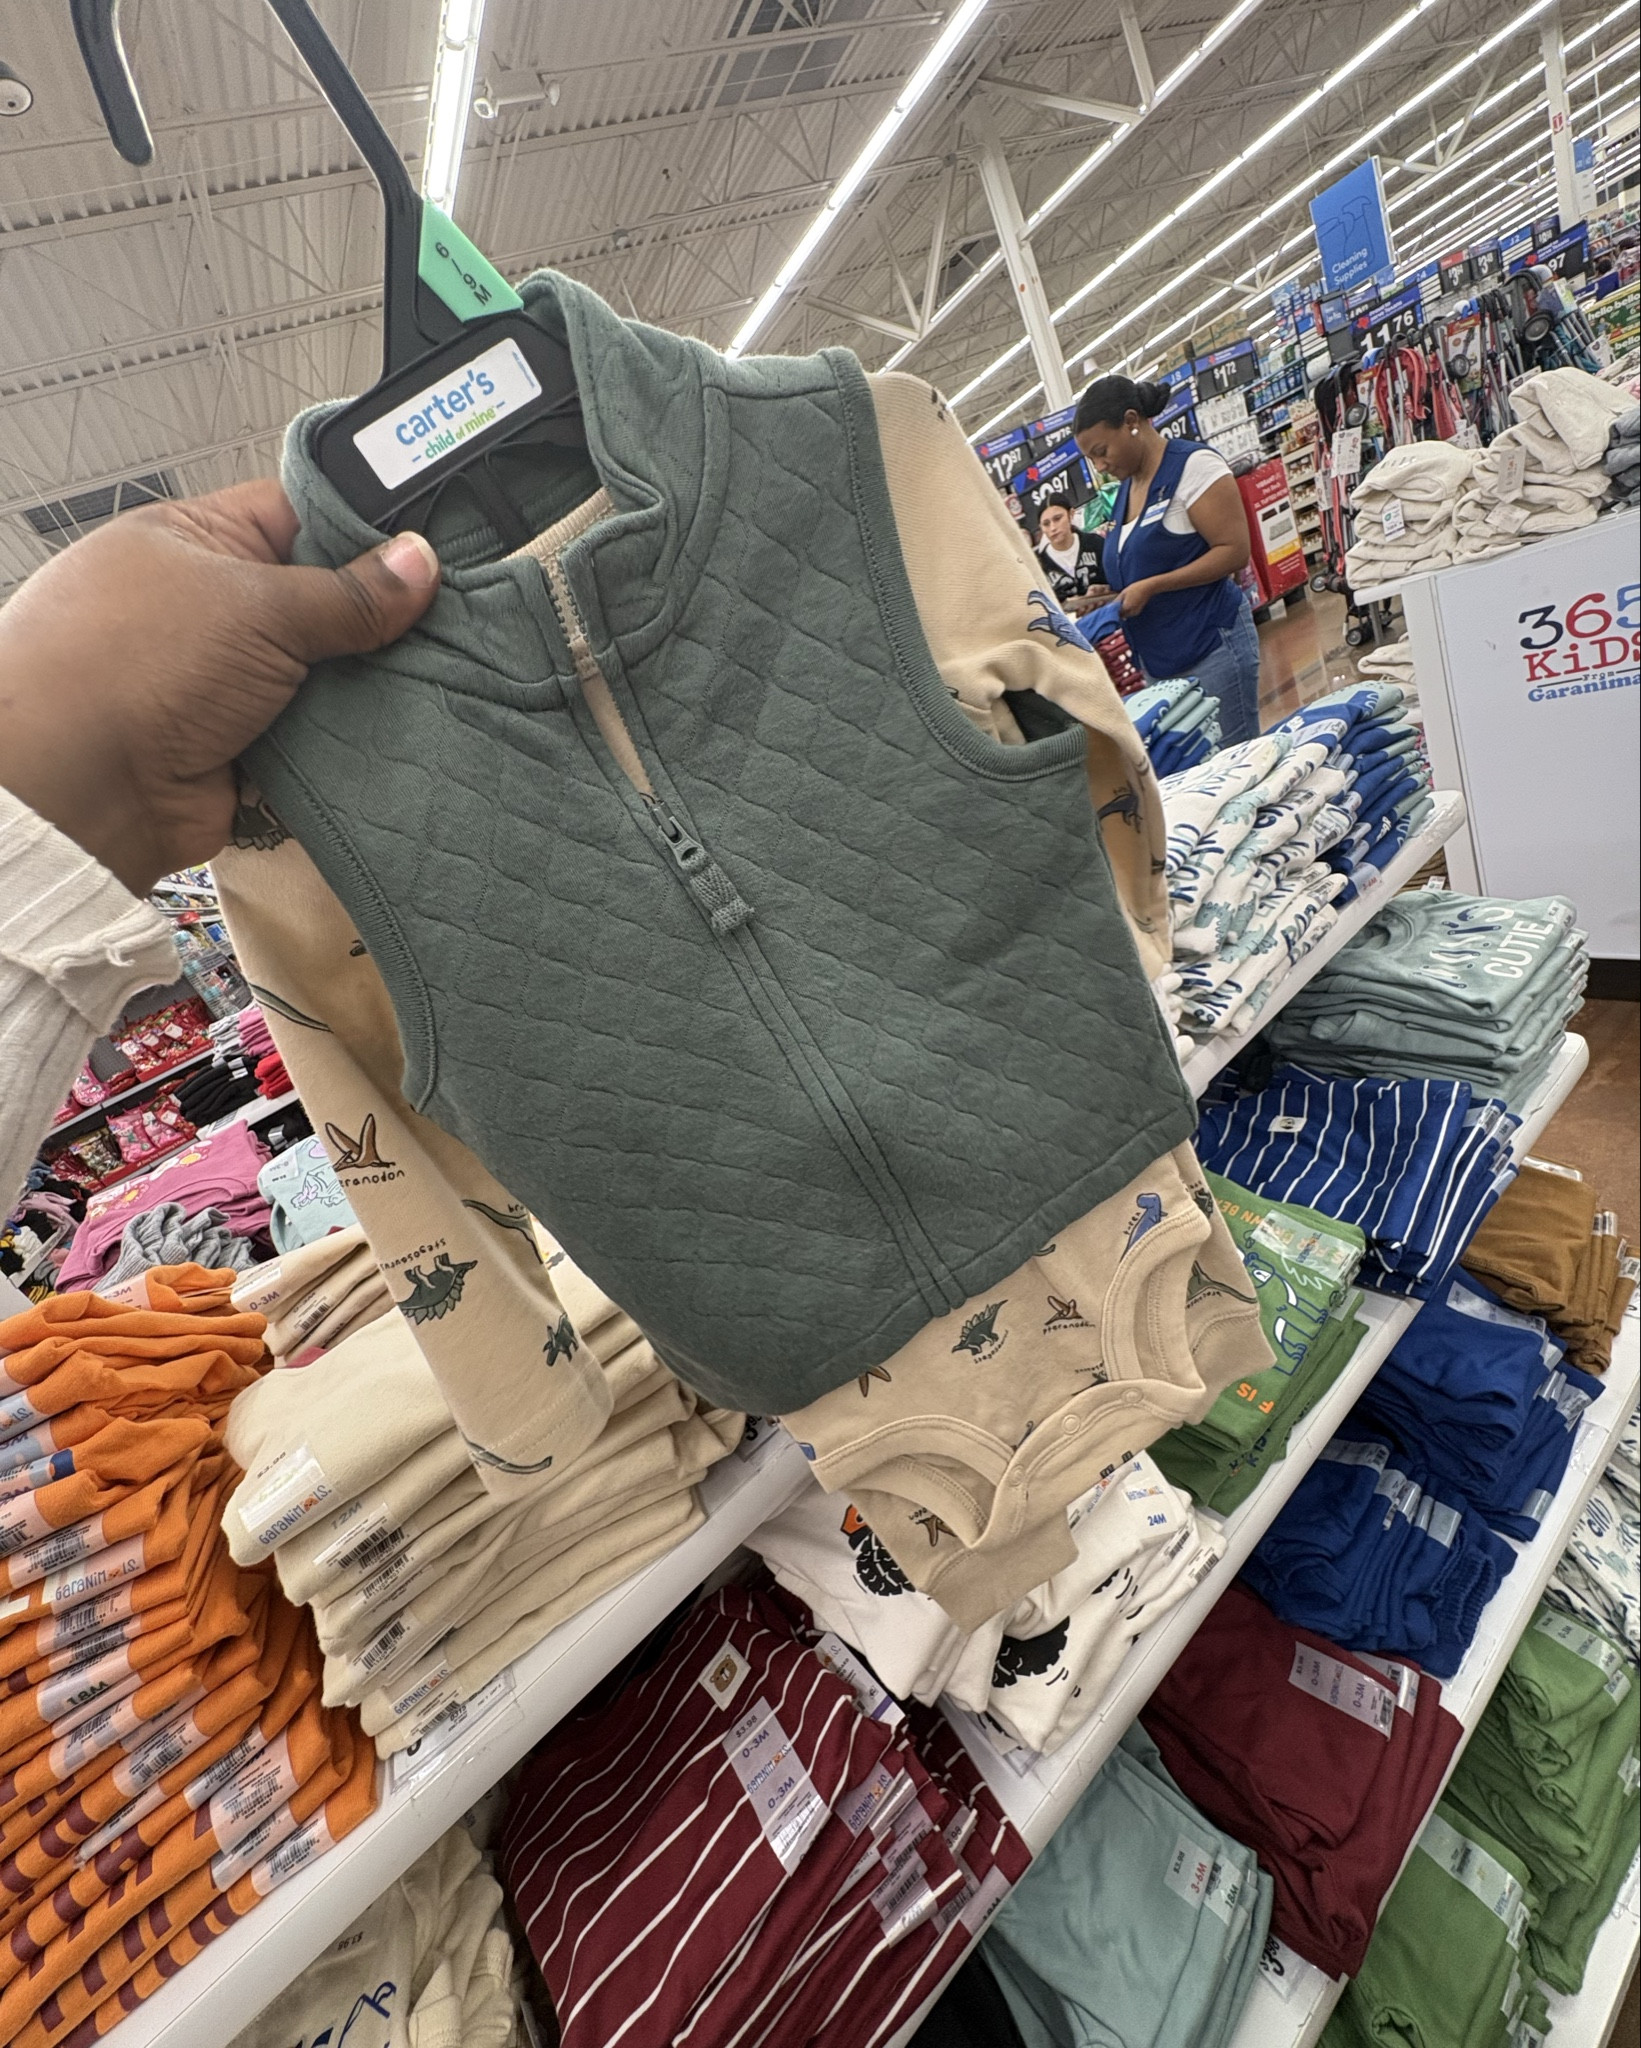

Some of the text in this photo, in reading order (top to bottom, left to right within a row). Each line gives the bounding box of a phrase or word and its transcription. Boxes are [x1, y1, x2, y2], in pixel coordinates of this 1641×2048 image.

[1331, 248, 1369, 274] Cleaning
[1333, 260, 1369, 286] Supplies
[395, 369, 495, 446] carter's
[424, 408, 496, 459] child of mine
[1483, 920, 1554, 979] CUTIE
[249, 1290, 280, 1311] 0-3M
[1236, 1382, 1259, 1402] IS
[1147, 1512, 1168, 1527] 24M
[735, 1714, 758, 1739] $3.98
[742, 1728, 770, 1759] 0-3M
[767, 1775, 796, 1810] 0-3M
[1190, 1861, 1208, 1895] 3-6M
[1224, 1884, 1240, 1909] 18M
